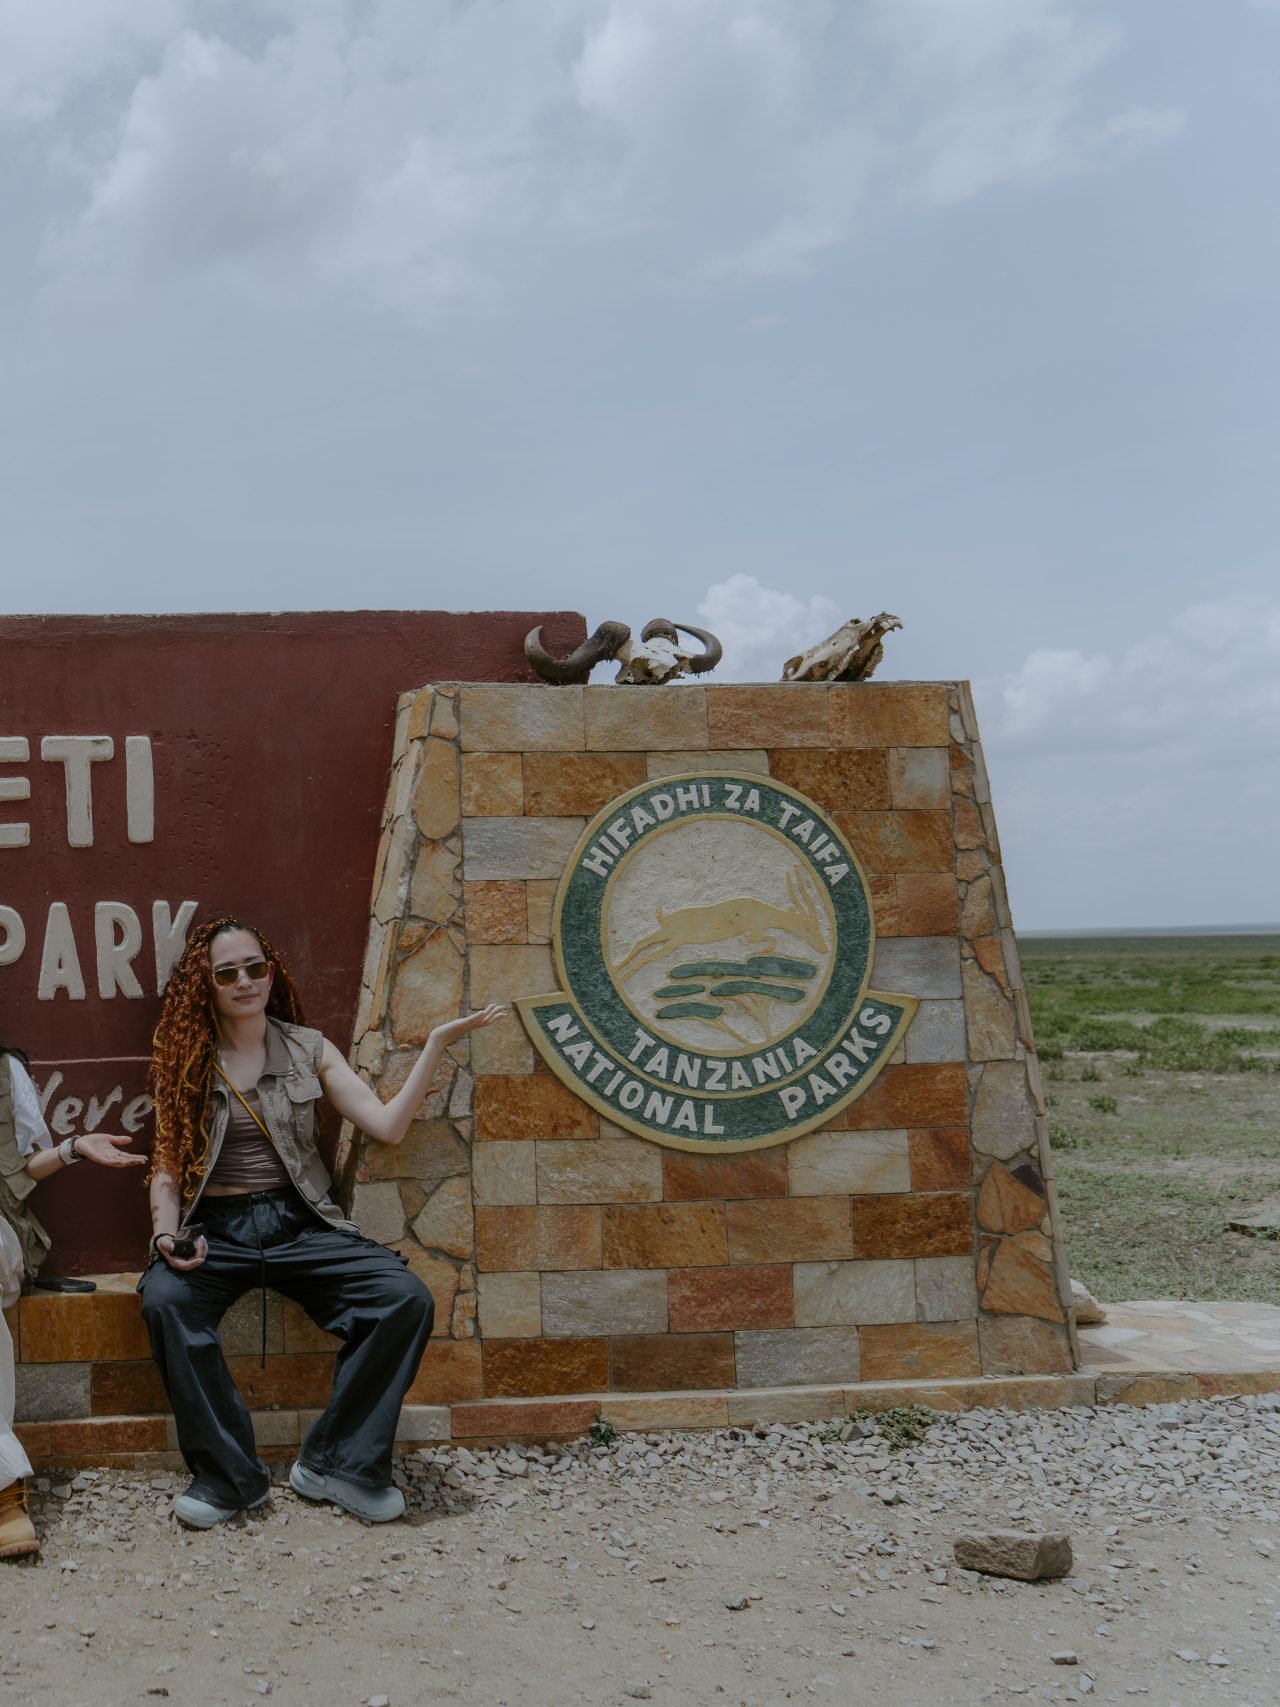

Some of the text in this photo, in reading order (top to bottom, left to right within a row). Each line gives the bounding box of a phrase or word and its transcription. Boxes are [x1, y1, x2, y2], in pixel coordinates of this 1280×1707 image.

[581, 784, 850, 887] HIFADHI ZA TAIFA
[547, 1007, 892, 1135] NATIONAL PARKS
[626, 1029, 818, 1092] TANZANIA
